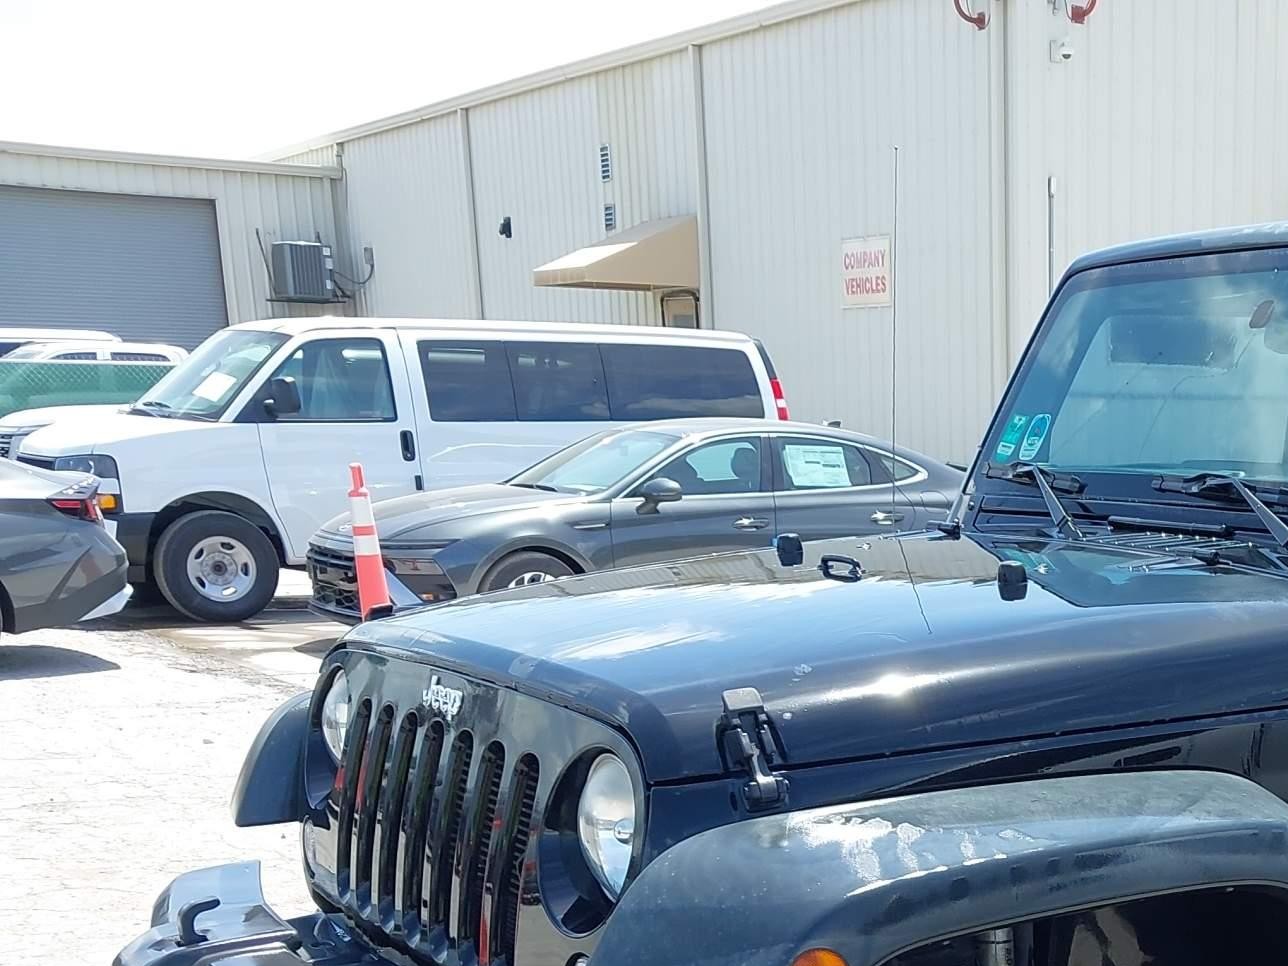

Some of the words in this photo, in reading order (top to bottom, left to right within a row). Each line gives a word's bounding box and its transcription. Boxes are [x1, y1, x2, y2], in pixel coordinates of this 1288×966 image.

[843, 249, 886, 270] COMPANY
[844, 275, 887, 296] VEHICLES
[422, 675, 463, 721] Jeep
